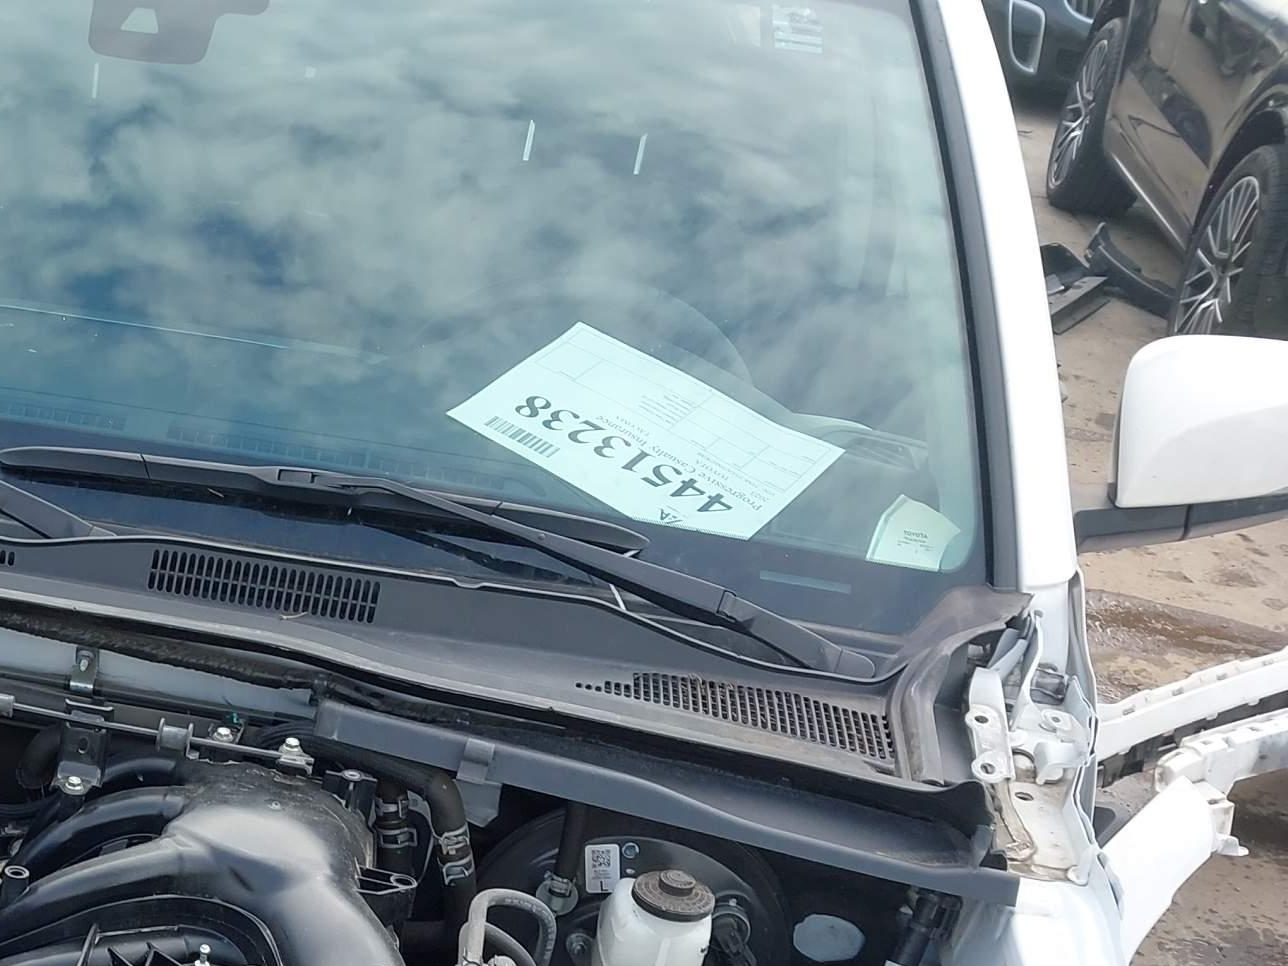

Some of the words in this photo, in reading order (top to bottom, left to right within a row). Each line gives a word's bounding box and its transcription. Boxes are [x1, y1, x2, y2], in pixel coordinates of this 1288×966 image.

[595, 415, 647, 447] Insurance
[514, 395, 733, 513] 44513238
[647, 445, 697, 474] Casualty
[697, 472, 762, 511] Progressive
